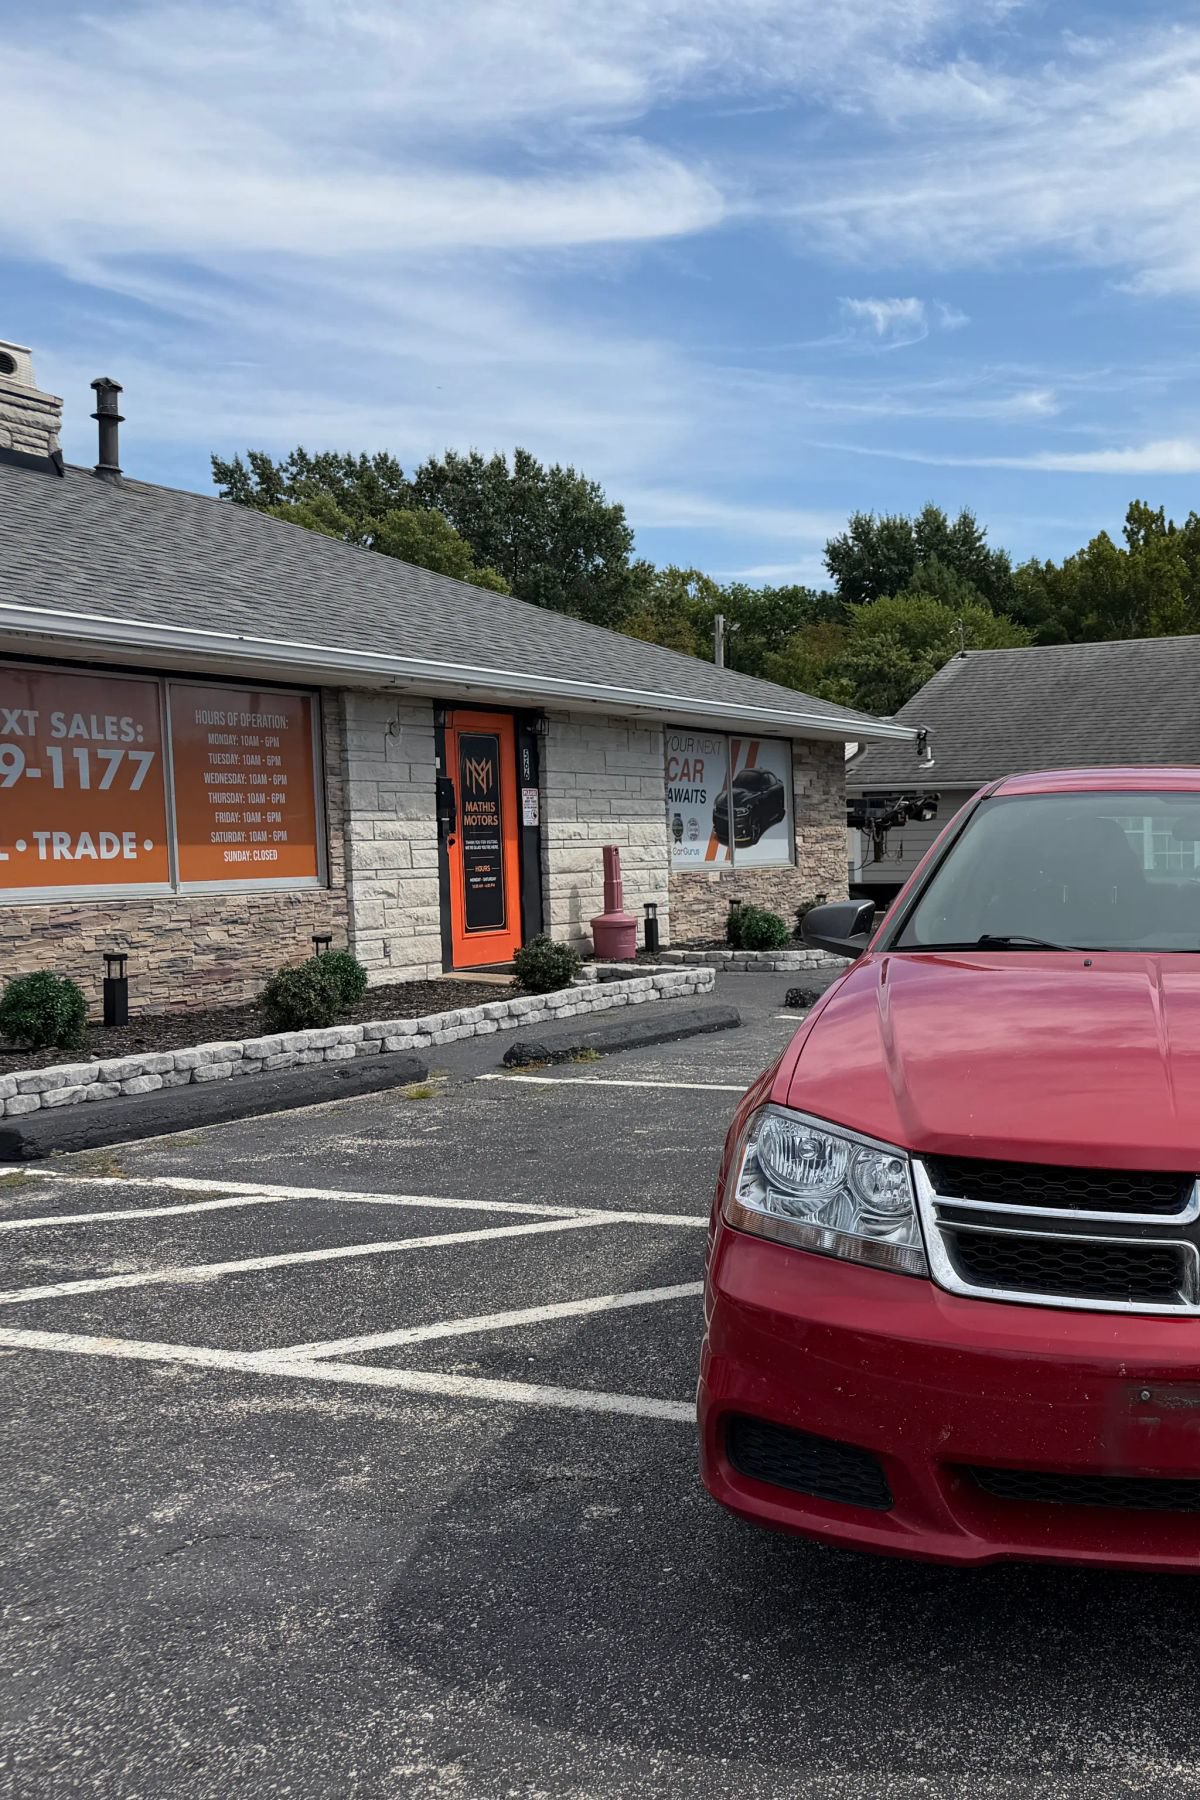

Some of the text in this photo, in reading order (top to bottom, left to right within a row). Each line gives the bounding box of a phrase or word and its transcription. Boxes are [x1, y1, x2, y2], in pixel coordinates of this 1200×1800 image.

[195, 709, 288, 729] HOURS OF OPERATION:
[50, 712, 144, 743] SALES:
[208, 733, 238, 746] MONDAY:
[241, 735, 259, 747] 10AM
[265, 736, 280, 748] 6PM
[665, 735, 722, 755] YOUR NEXT
[208, 753, 240, 765] TUESDAY:
[242, 755, 261, 766] 10AM
[266, 756, 281, 767] 6PM
[667, 756, 705, 783] CAR
[203, 772, 246, 785] WEDNESDAY:
[249, 774, 267, 785] 10AM
[273, 774, 287, 785] 6PM
[208, 792, 245, 804] THURSDAY:
[247, 793, 265, 804] 10AM
[271, 793, 286, 804] 6PM
[667, 788, 707, 804] AWAITS
[465, 801, 496, 812] MATHIS
[215, 811, 240, 823] FRIDAY:
[242, 812, 261, 823] 10AM
[267, 812, 281, 823] 6PM
[464, 815, 498, 826] MOTORS
[210, 831, 247, 843] SATURDAY:
[249, 831, 268, 842] 10AM
[273, 830, 287, 842] 6PM
[33, 831, 137, 860] TRADE
[223, 849, 278, 862] SUNDAY: CLOSED
